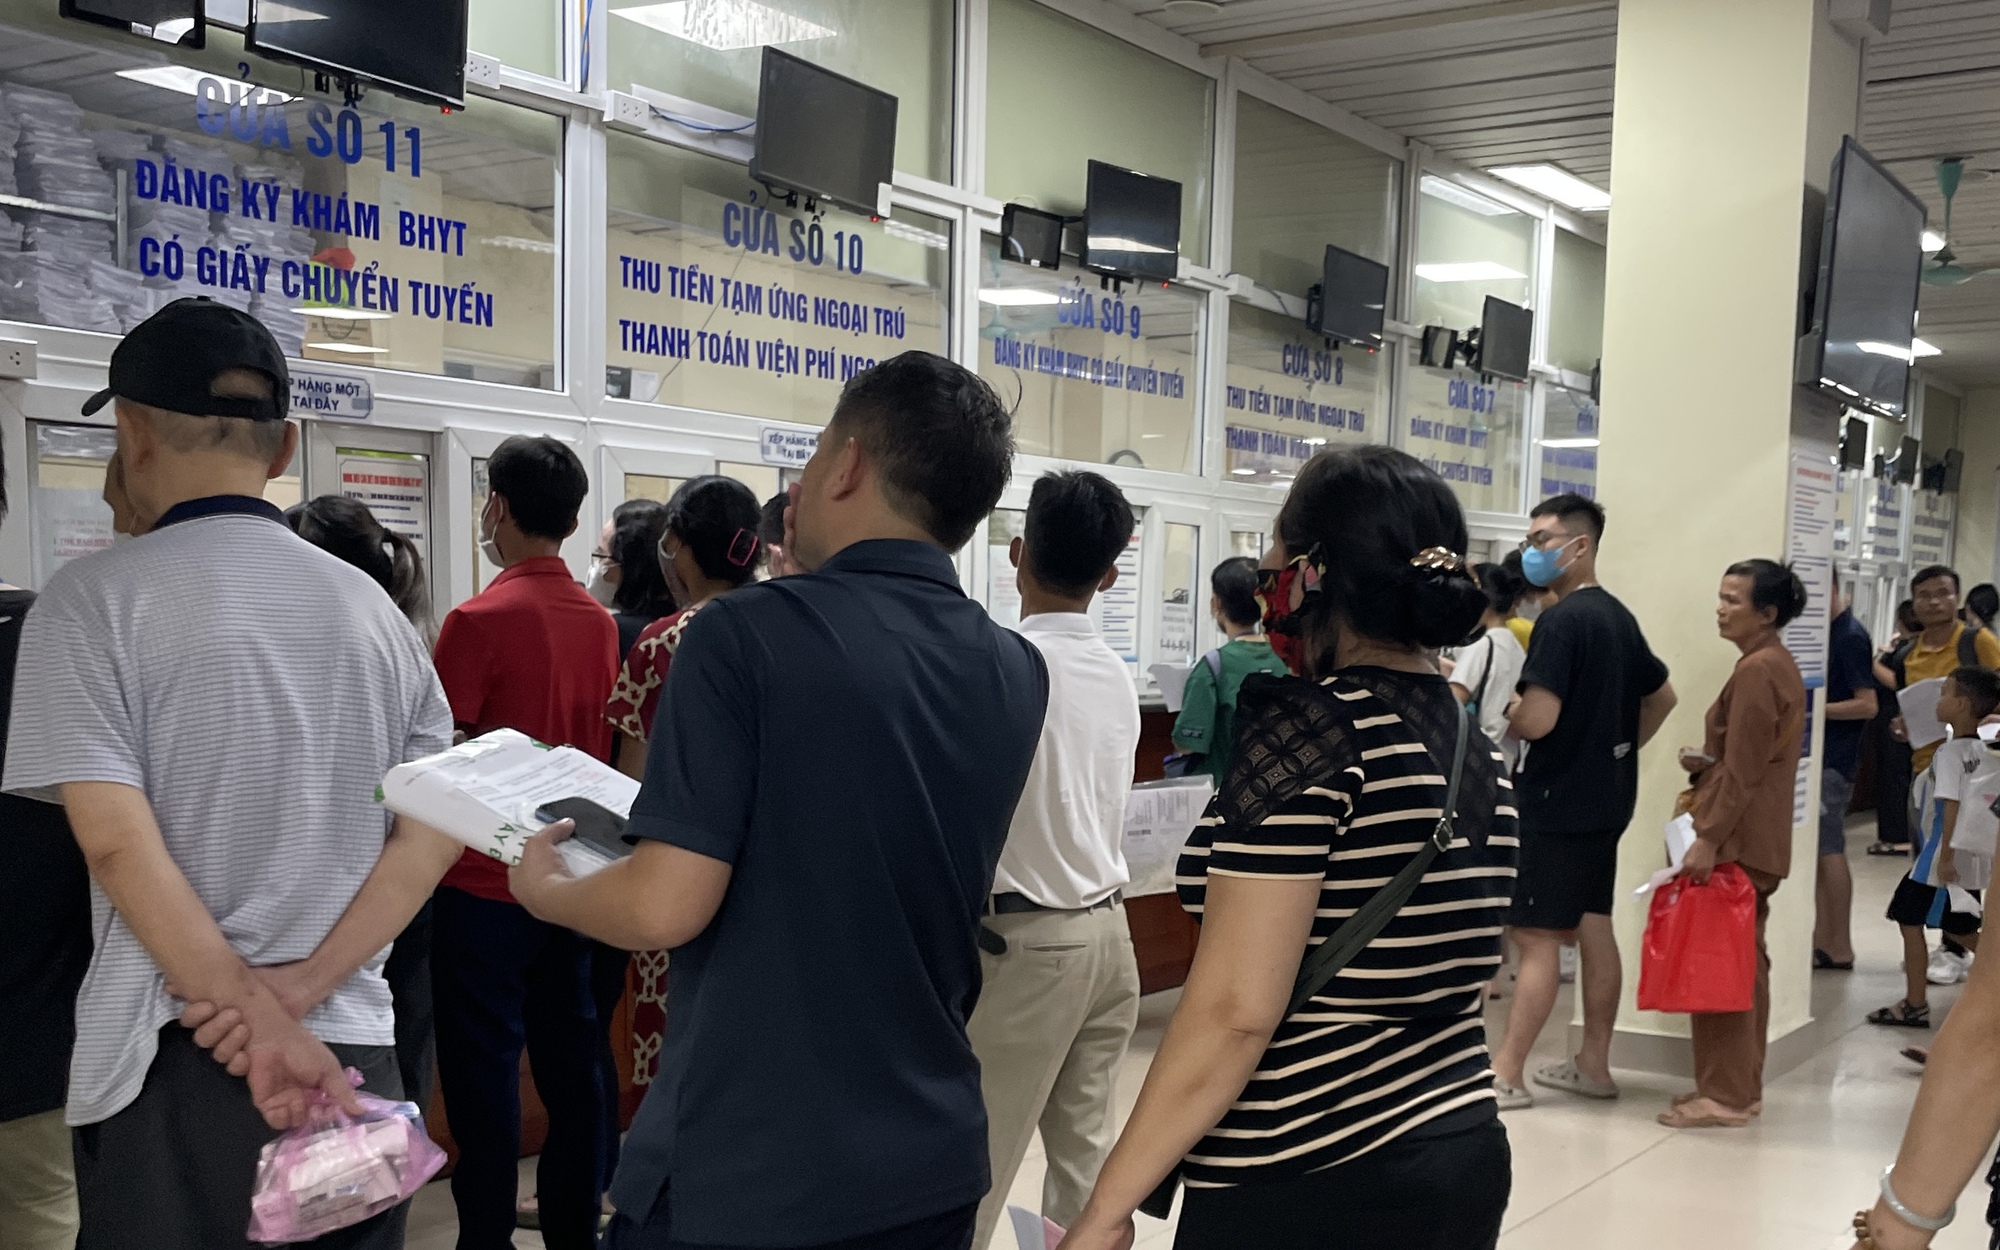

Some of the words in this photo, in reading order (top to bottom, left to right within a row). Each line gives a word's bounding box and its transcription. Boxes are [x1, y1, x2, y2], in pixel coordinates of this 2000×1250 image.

[196, 62, 291, 149] CỬA
[379, 121, 420, 178] 11
[136, 156, 230, 214] ĐĂNG
[241, 178, 281, 222] KÝ
[292, 191, 380, 241] KHÁM
[399, 210, 467, 257] BHYT
[723, 190, 780, 257] CỬA
[789, 210, 826, 266] SỐ
[834, 231, 863, 275] 10
[139, 234, 184, 281] CÓ
[197, 243, 271, 293] GIẤY
[281, 261, 399, 314] CHUYỂN
[408, 281, 494, 328] TUYẾN
[620, 255, 661, 294] THU
[668, 264, 714, 305] TIỀN
[721, 277, 763, 316] TẠM
[768, 282, 808, 324] ỨNG
[814, 296, 868, 337] NGOẠI
[873, 306, 905, 339] TRÚ
[1130, 305, 1141, 340] 9
[619, 319, 690, 360] THANH
[697, 329, 749, 368] TOÁN
[756, 337, 799, 378] VIỆN
[805, 346, 836, 380] PHÍ
[1335, 356, 1343, 386] 8
[298, 377, 332, 393] HÀNG
[314, 400, 339, 411] ĐÂY
[1227, 386, 1246, 410] THU
[1488, 390, 1495, 414] 7
